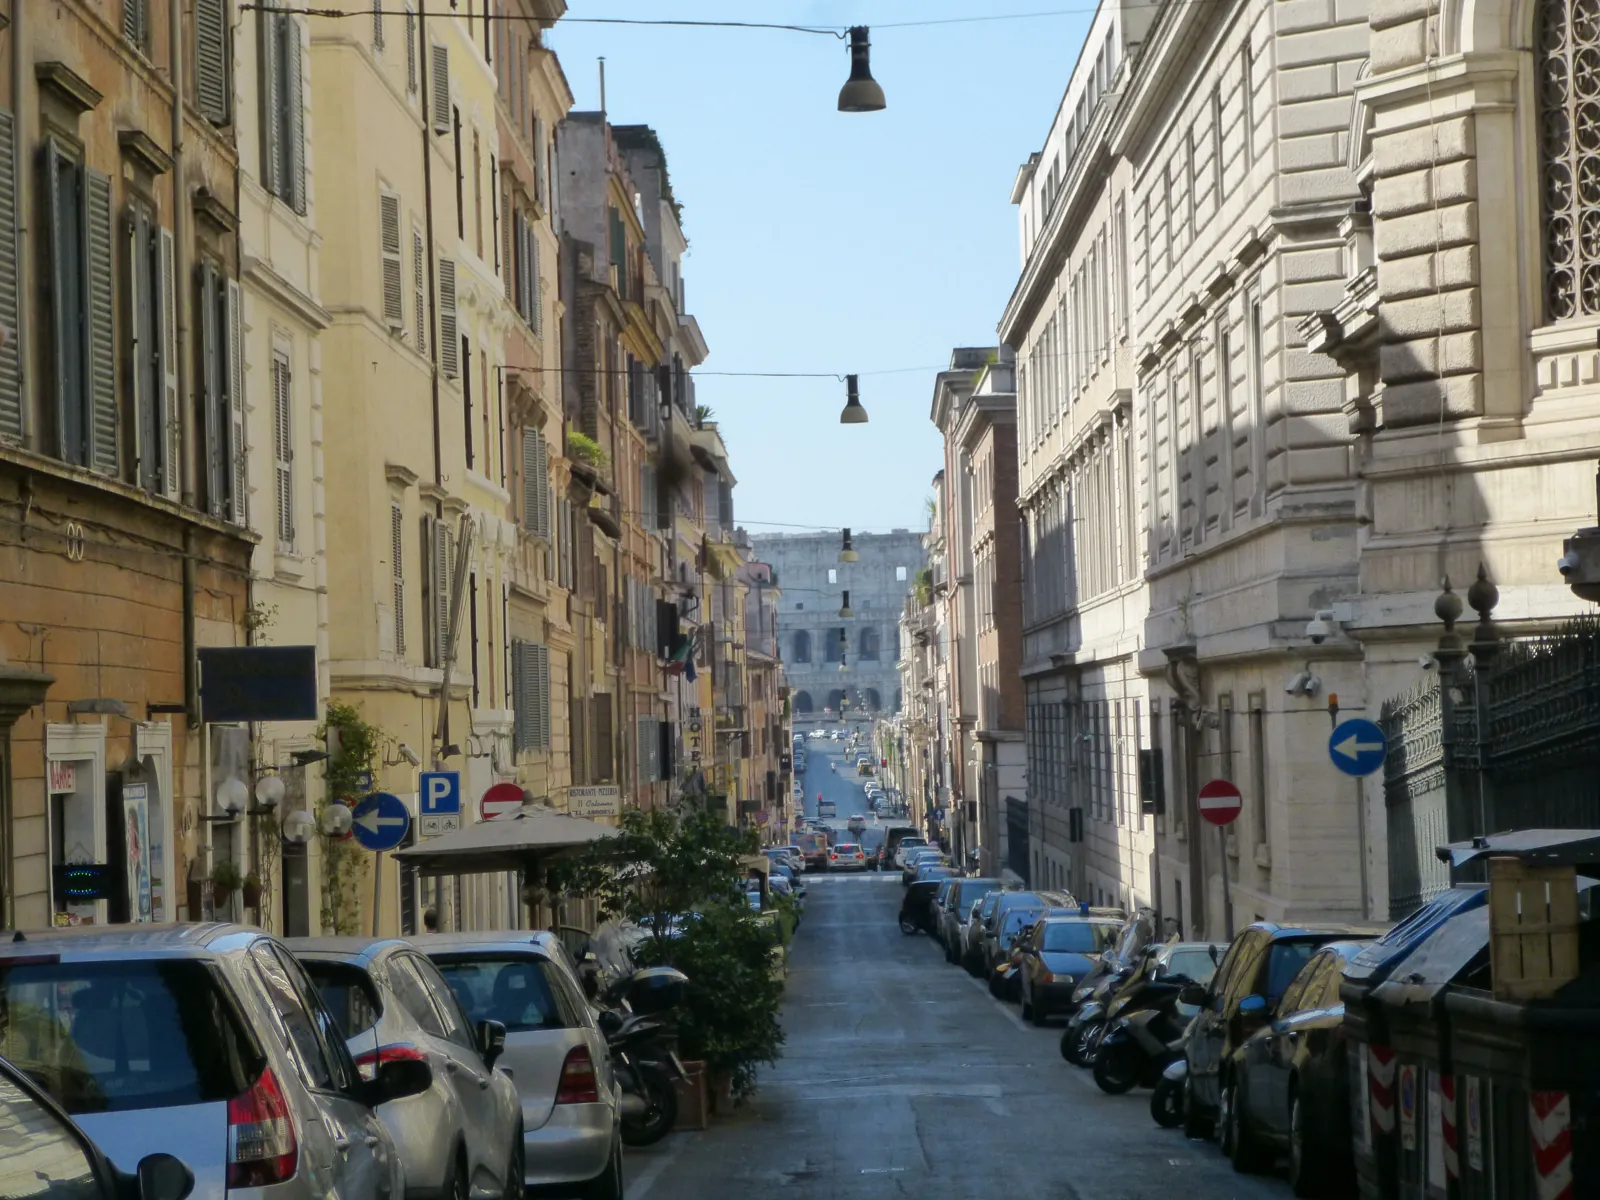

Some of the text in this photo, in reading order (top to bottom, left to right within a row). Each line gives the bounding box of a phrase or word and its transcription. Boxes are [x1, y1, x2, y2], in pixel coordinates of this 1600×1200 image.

[428, 777, 451, 809] P
[569, 787, 618, 797] RISTORANTE PIZZERIA
